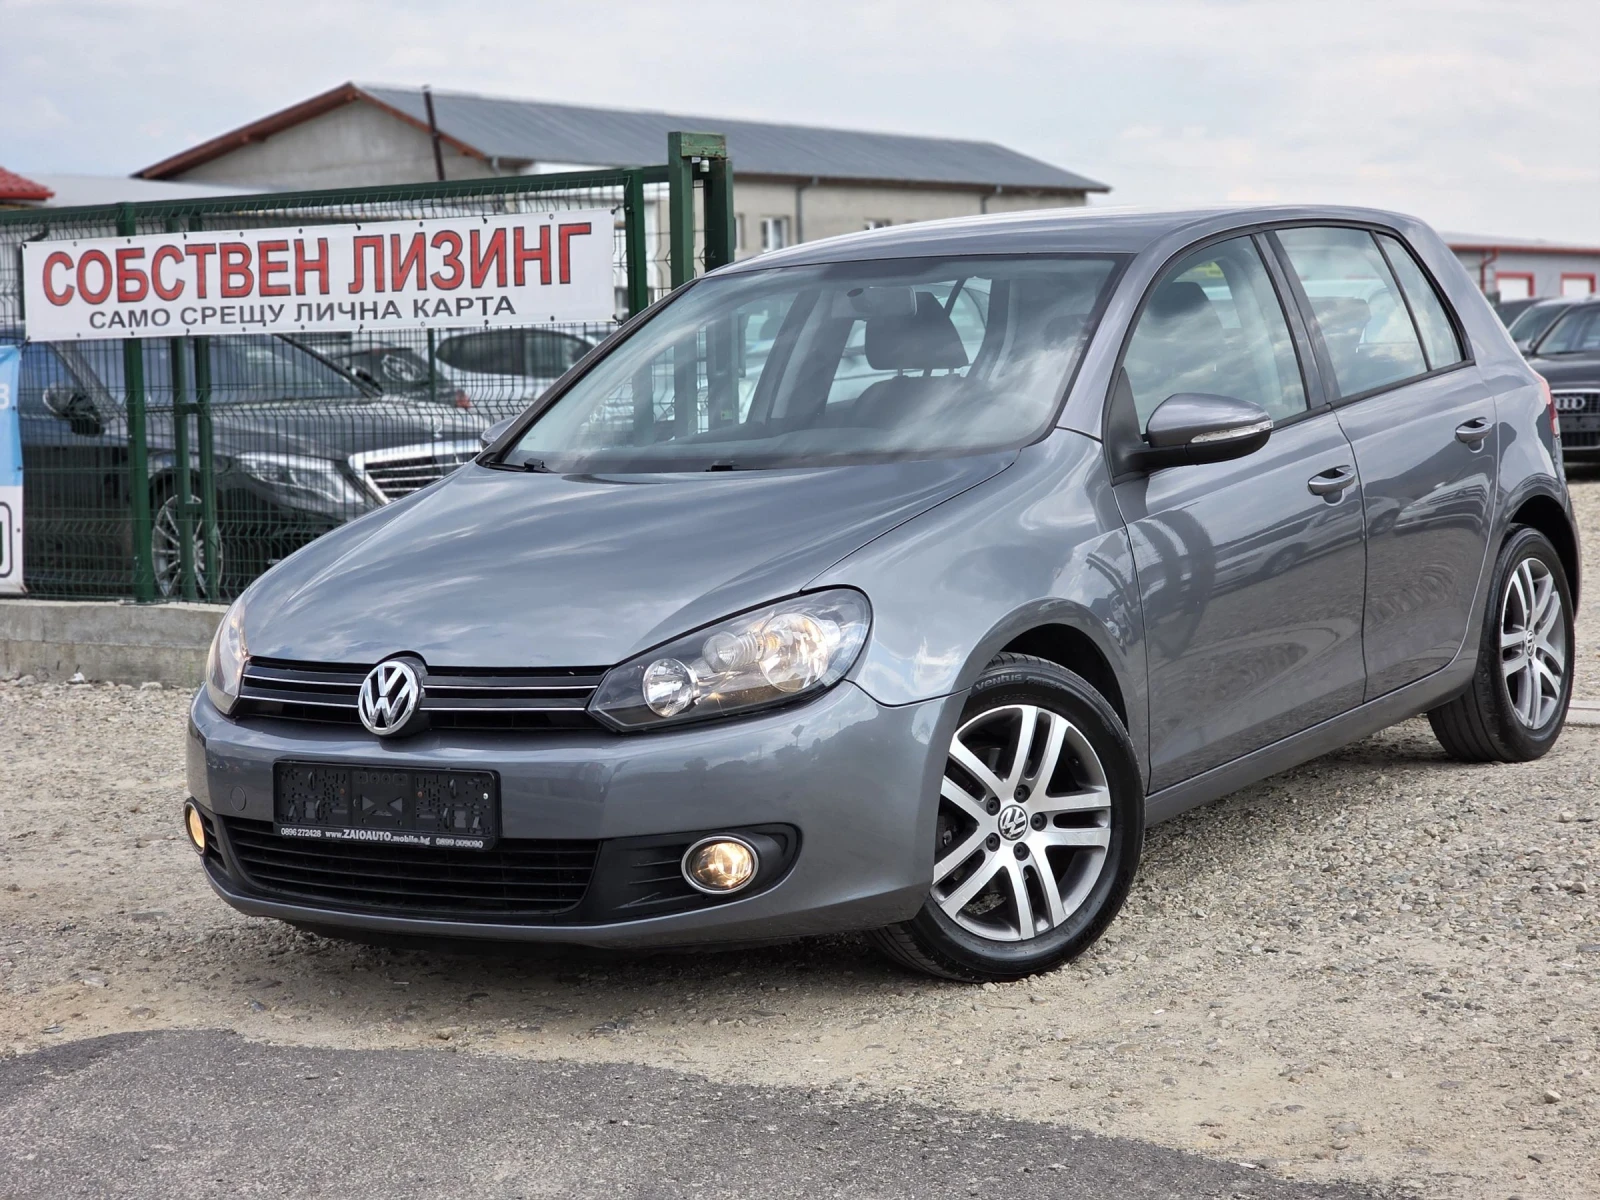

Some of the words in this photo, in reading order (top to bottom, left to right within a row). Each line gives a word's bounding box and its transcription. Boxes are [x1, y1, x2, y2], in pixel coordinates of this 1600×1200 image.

[42, 237, 329, 307] СОБСТВЕН
[348, 222, 592, 294] ЛИЗИНГ
[89, 307, 171, 329] САМО
[180, 304, 285, 327] СРЕЩУ
[294, 299, 403, 322] ЛИЧНА
[413, 295, 516, 318] КАРТА
